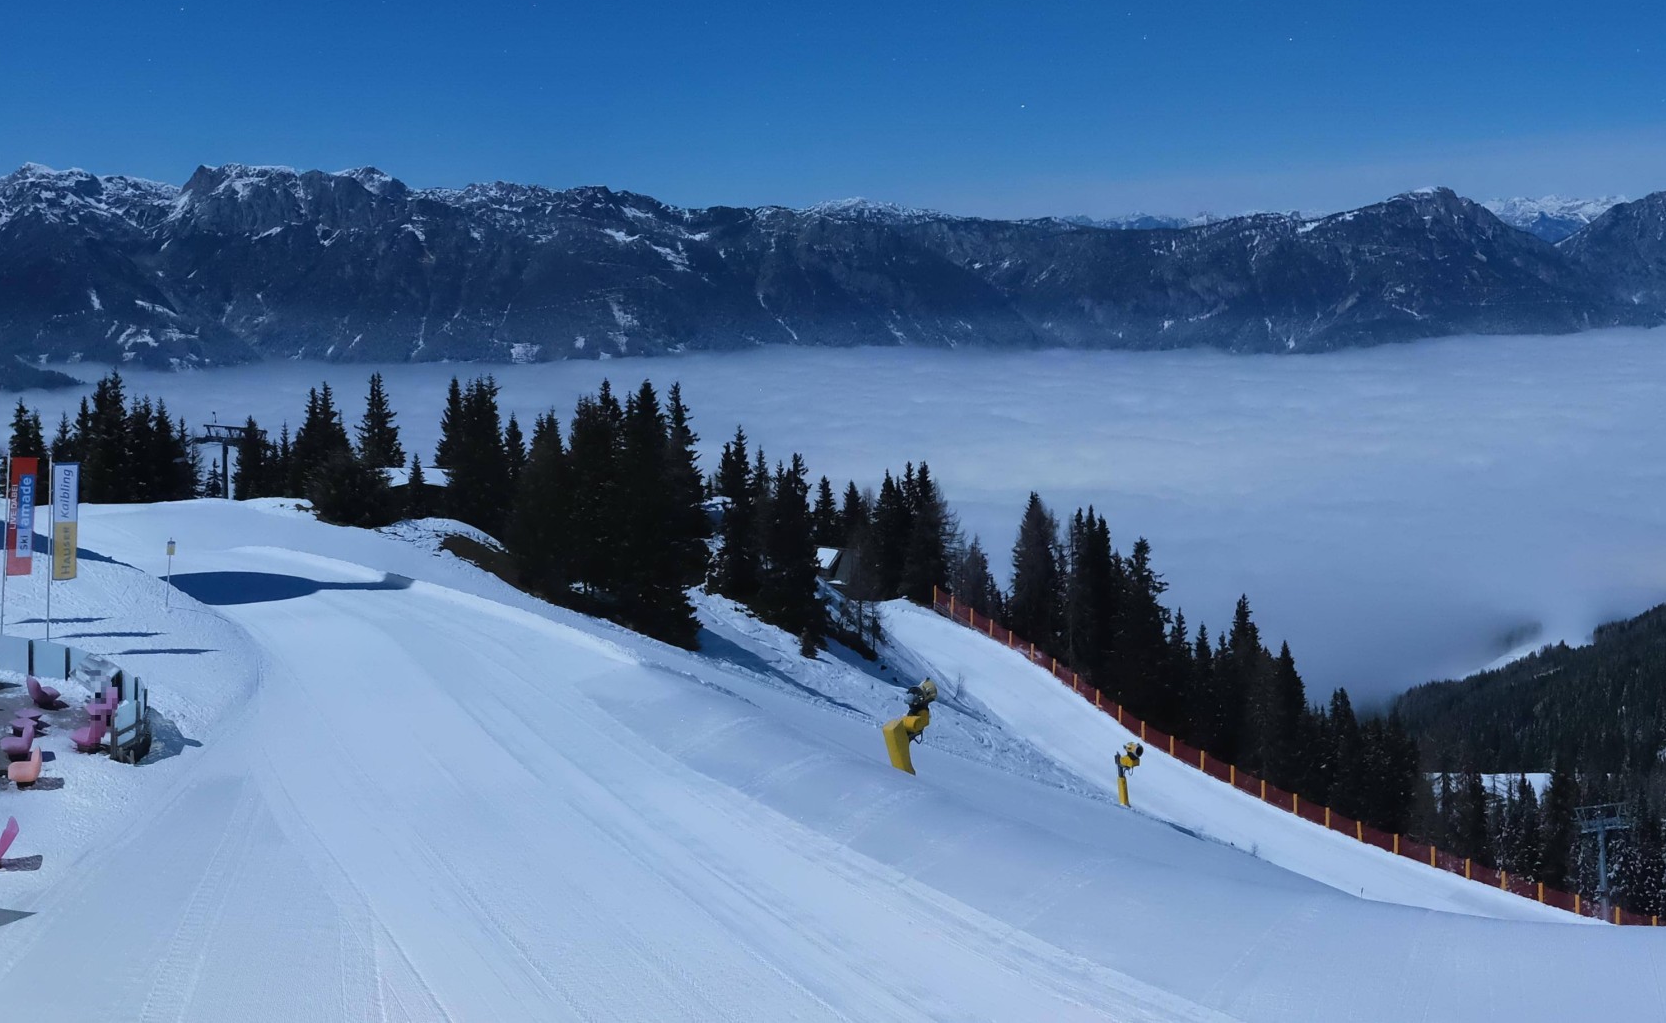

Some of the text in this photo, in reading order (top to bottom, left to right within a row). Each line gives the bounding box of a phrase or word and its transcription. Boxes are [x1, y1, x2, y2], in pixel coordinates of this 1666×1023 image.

[61, 468, 74, 519] Kaibling
[9, 512, 17, 530] LIVE
[19, 534, 29, 551] Ski
